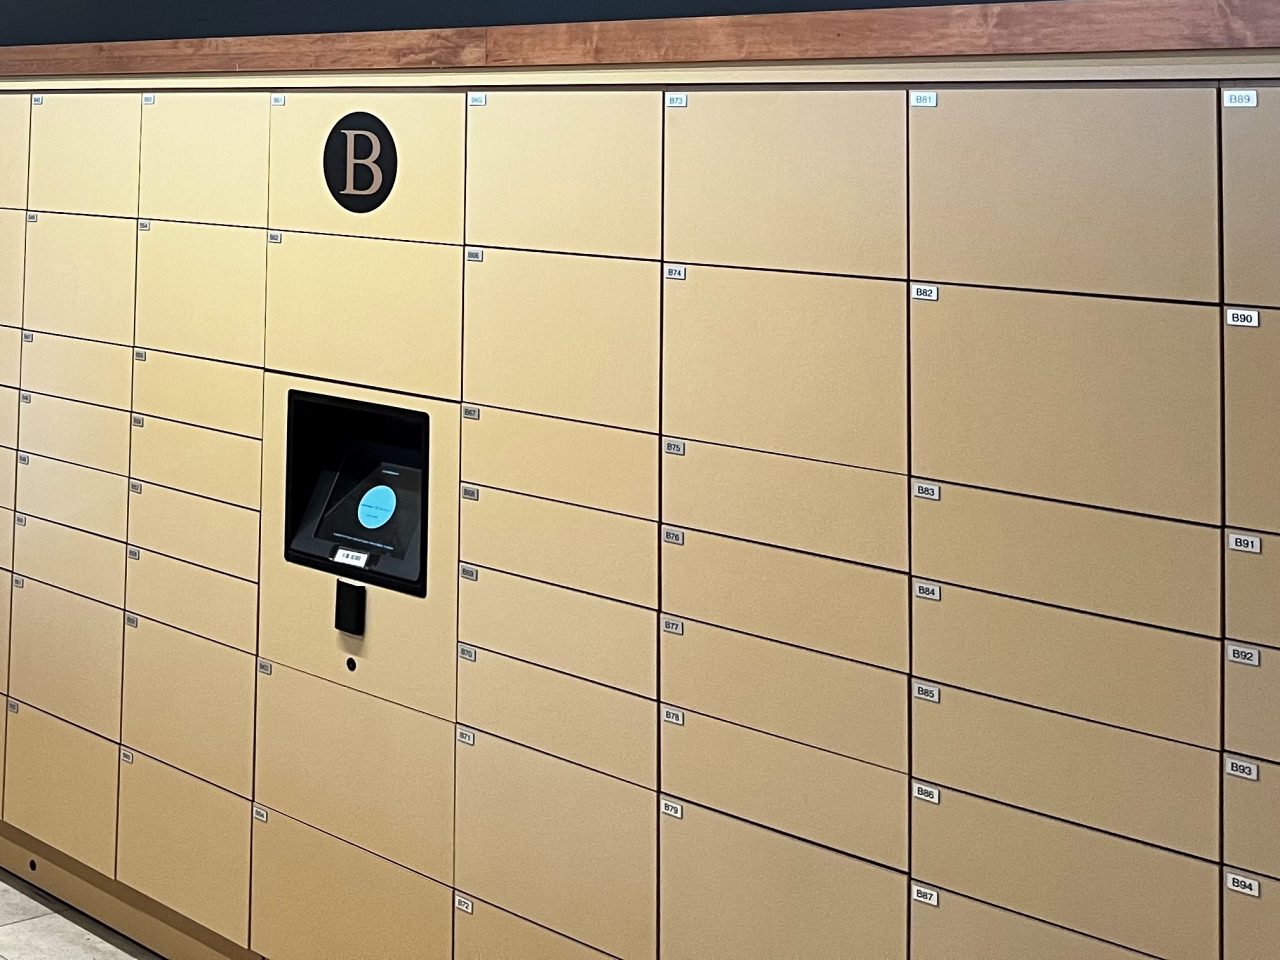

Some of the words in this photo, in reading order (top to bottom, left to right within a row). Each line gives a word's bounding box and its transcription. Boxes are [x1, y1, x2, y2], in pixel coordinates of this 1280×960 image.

[916, 95, 932, 103] B81
[1229, 95, 1251, 104] B89
[340, 130, 383, 196] B
[668, 268, 681, 276] B74
[916, 288, 933, 297] B82
[1232, 313, 1252, 323] B90
[666, 443, 681, 452] B75
[917, 486, 934, 496] B83
[666, 531, 680, 541] B76
[1235, 538, 1254, 549] B91
[918, 586, 935, 595] B84
[665, 621, 679, 630] B77
[1232, 649, 1254, 661] B92
[917, 686, 935, 698] B85
[666, 710, 680, 721] B78
[459, 731, 471, 741] B71
[1231, 762, 1252, 776] B93
[917, 787, 935, 799] B86
[664, 803, 679, 814] B79
[1232, 877, 1253, 892] B94
[916, 889, 934, 902] B87
